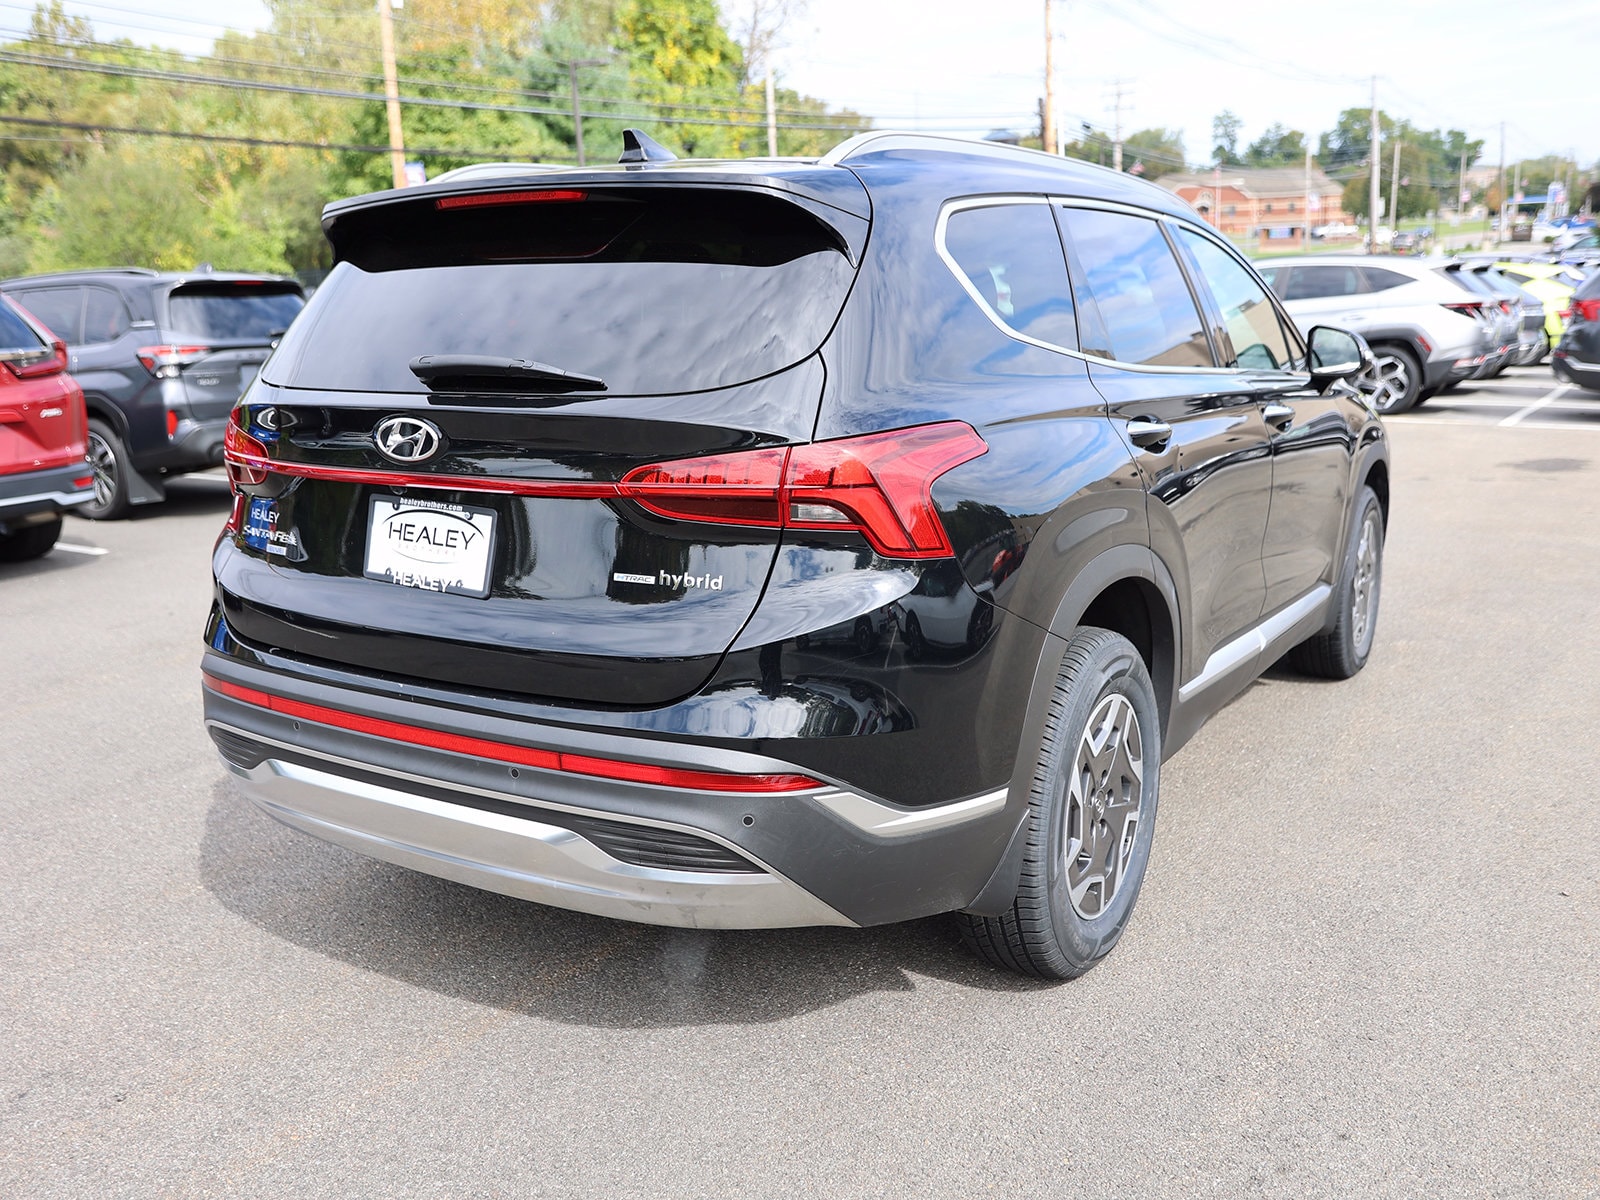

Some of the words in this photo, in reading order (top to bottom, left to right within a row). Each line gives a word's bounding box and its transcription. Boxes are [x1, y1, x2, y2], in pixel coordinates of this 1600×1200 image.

[400, 497, 463, 511] healeybrothers.com
[251, 507, 280, 523] HEALEY
[388, 521, 476, 550] HEALEY
[393, 571, 451, 592] HEALEY
[659, 569, 724, 591] hybrid
